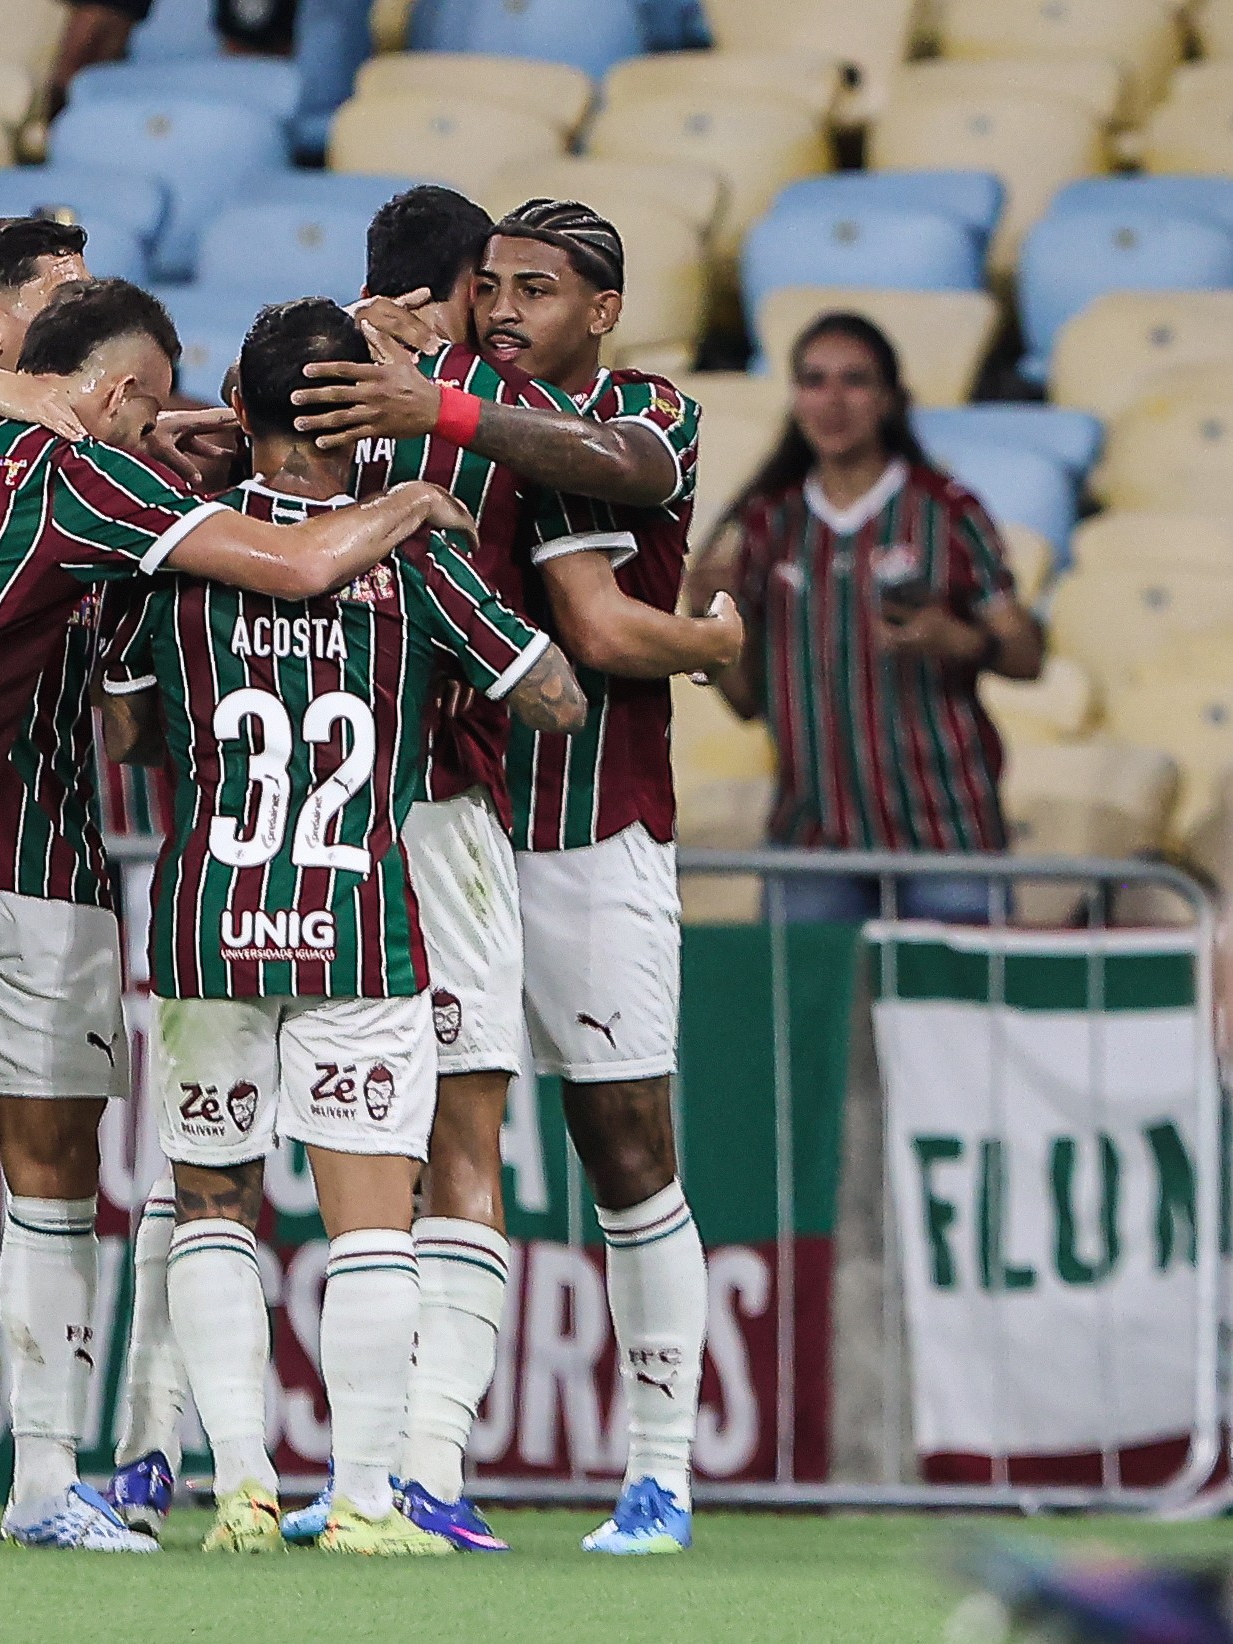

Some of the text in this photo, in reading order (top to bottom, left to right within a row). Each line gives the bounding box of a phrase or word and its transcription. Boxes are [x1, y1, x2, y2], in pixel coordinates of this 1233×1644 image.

[231, 616, 349, 660] ACOSTA
[209, 687, 376, 873] 32
[221, 910, 335, 949] UNIG
[220, 948, 294, 961] UNIVERSIDADE
[179, 1082, 224, 1123] Zé
[310, 1062, 357, 1104] Zé
